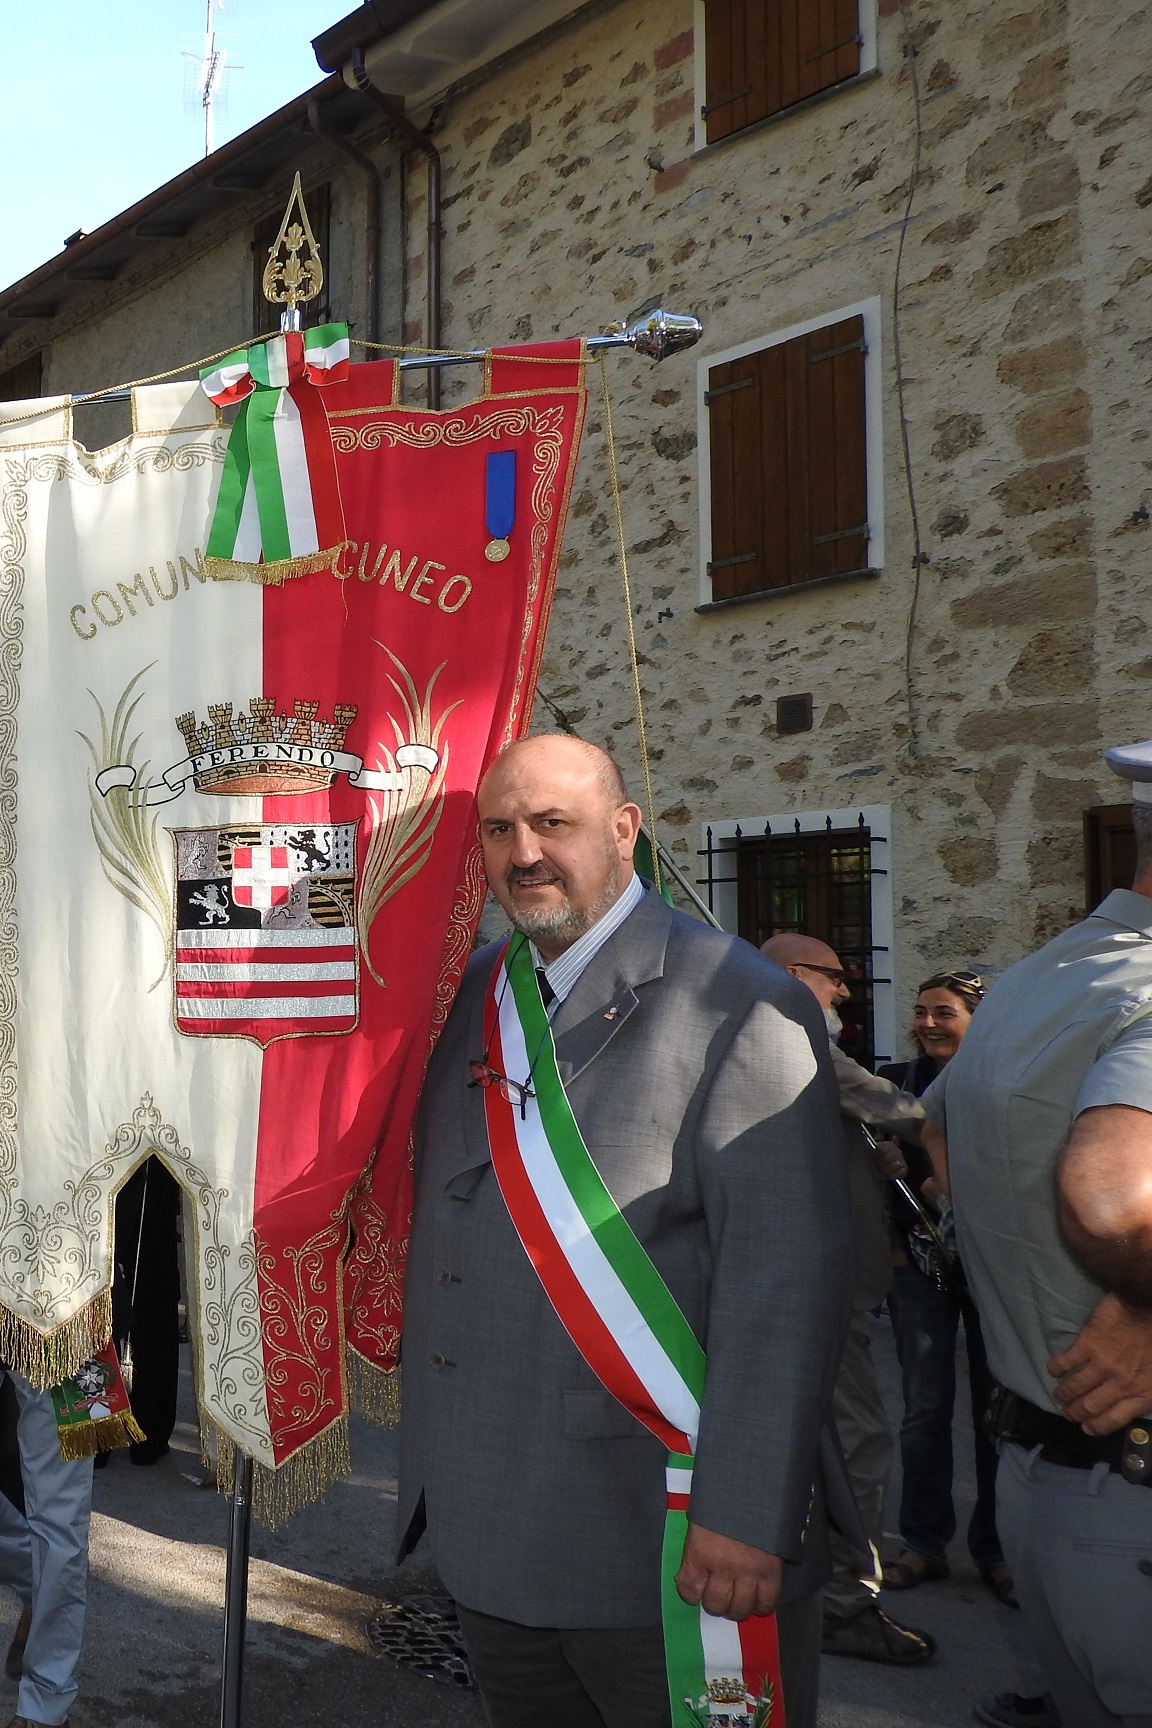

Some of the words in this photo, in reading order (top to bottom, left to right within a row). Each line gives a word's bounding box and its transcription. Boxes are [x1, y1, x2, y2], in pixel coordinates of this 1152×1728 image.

[70, 547, 208, 640] COMUN
[331, 540, 473, 614] CUNEO
[190, 744, 336, 775] FERENDO
